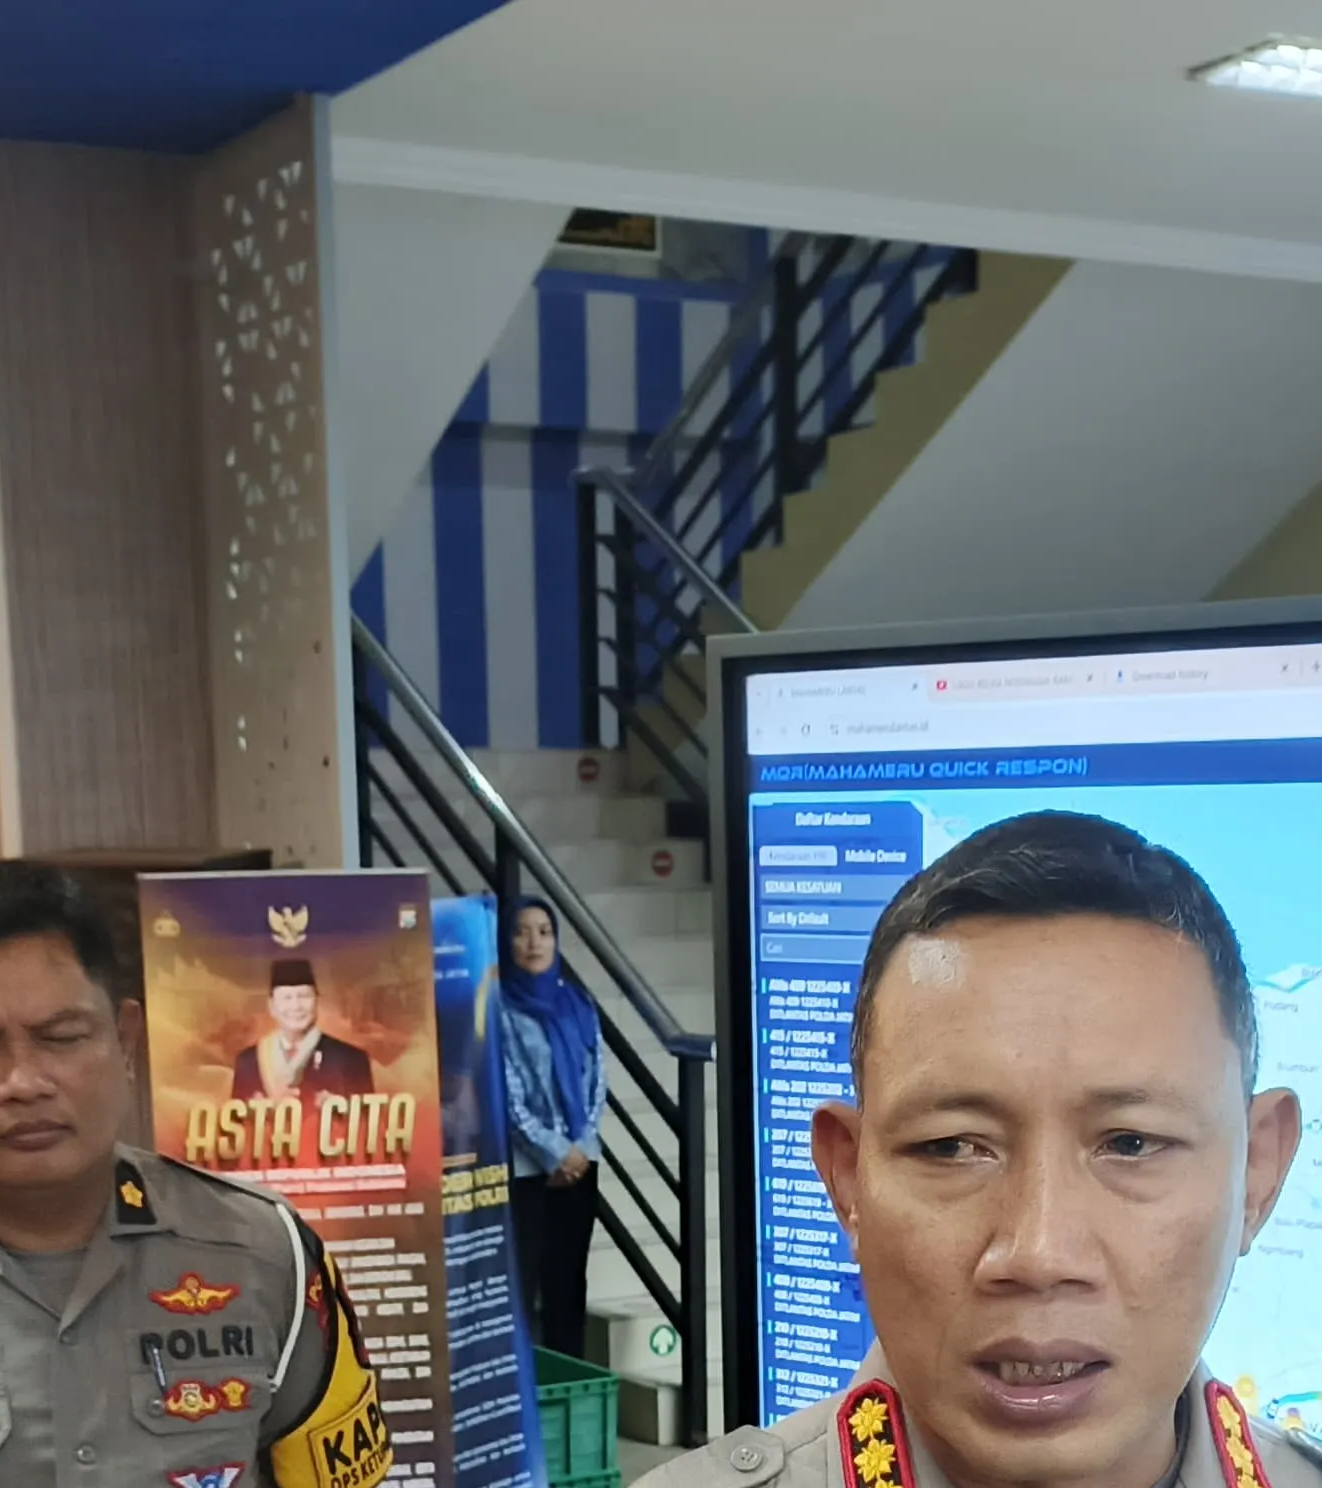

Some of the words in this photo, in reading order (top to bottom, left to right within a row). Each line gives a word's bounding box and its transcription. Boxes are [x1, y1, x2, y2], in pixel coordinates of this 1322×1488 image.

[929, 760, 989, 777] QUICK
[995, 756, 1088, 777] RESPON)
[186, 1097, 303, 1162] ASTA
[318, 1091, 417, 1159] CITA
[139, 1323, 254, 1366] POLRI
